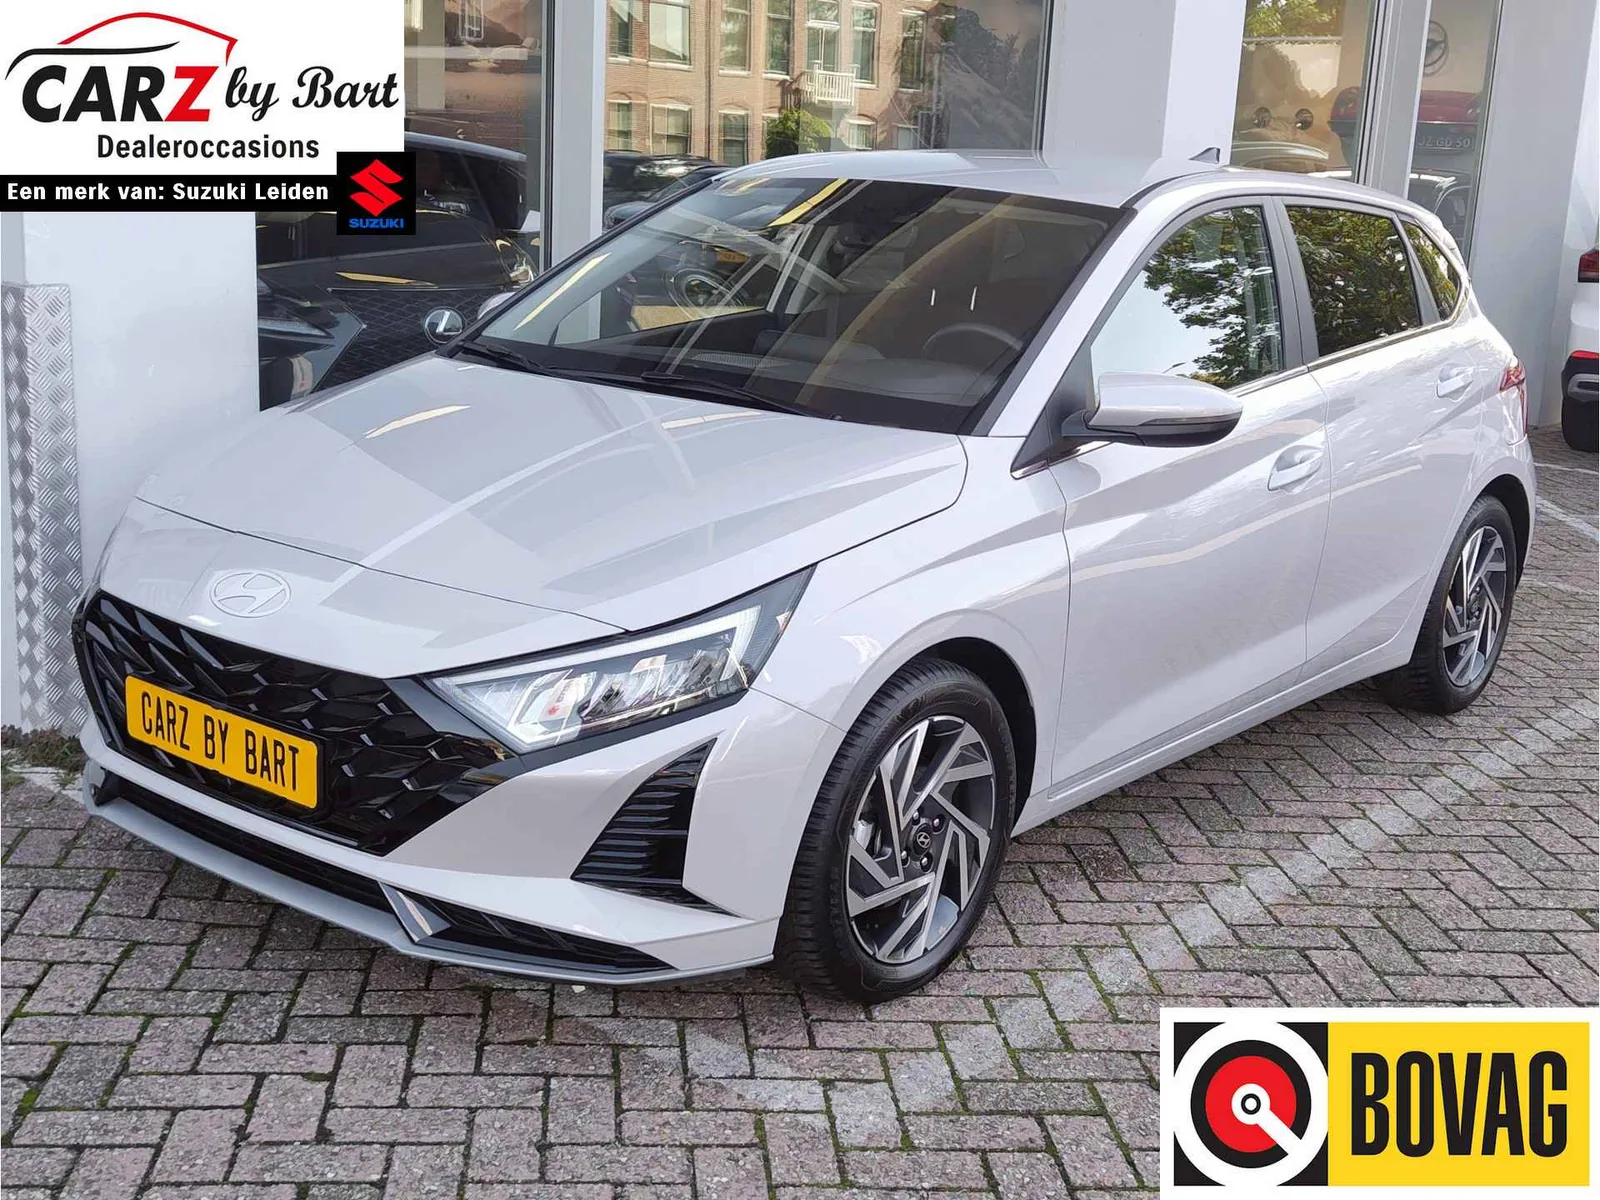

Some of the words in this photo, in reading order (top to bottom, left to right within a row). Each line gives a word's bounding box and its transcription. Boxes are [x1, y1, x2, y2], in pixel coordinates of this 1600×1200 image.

[141, 691, 190, 751] CARZ
[204, 715, 229, 765] BY
[245, 729, 299, 792] BART
